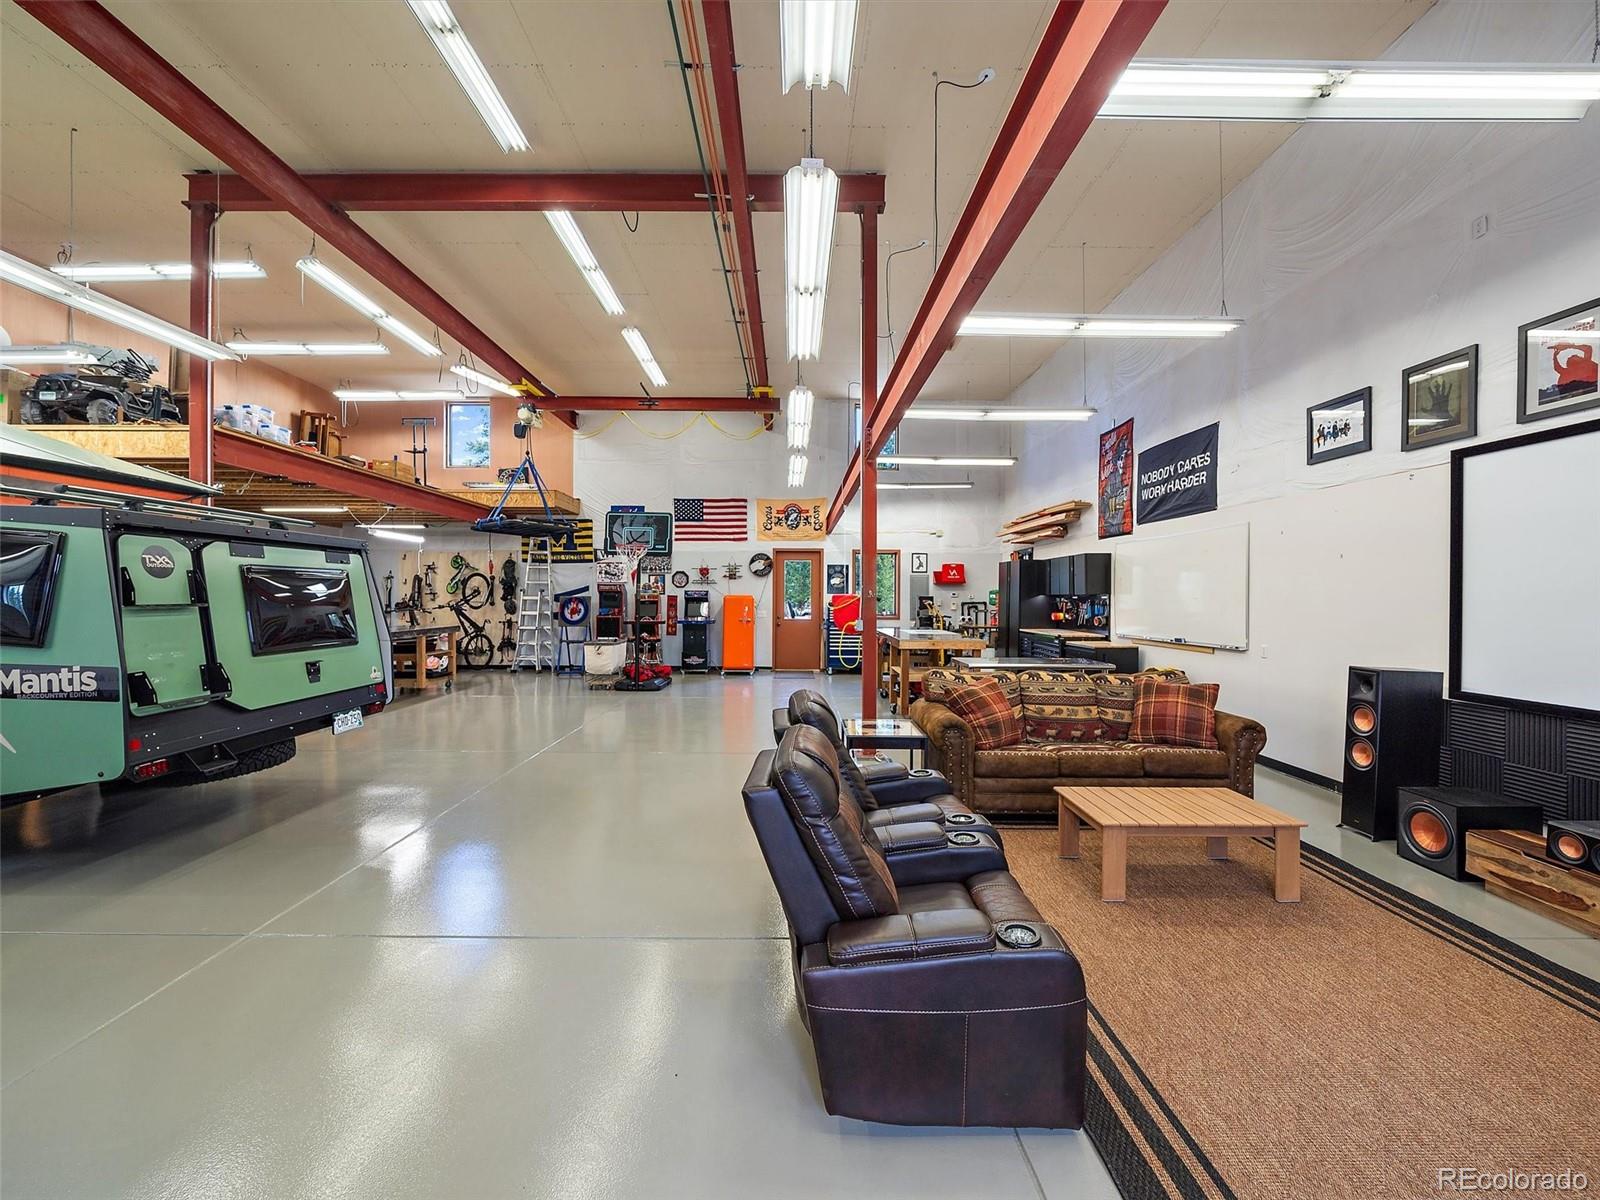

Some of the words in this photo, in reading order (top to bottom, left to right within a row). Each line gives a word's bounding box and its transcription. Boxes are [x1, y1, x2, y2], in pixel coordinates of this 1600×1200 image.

[1141, 464, 1176, 485] NOBODY
[1177, 452, 1211, 473] CARES
[1167, 471, 1207, 493] HARDER
[762, 505, 773, 532] Coors
[813, 505, 824, 532] Coors
[0, 665, 98, 694] Mantis
